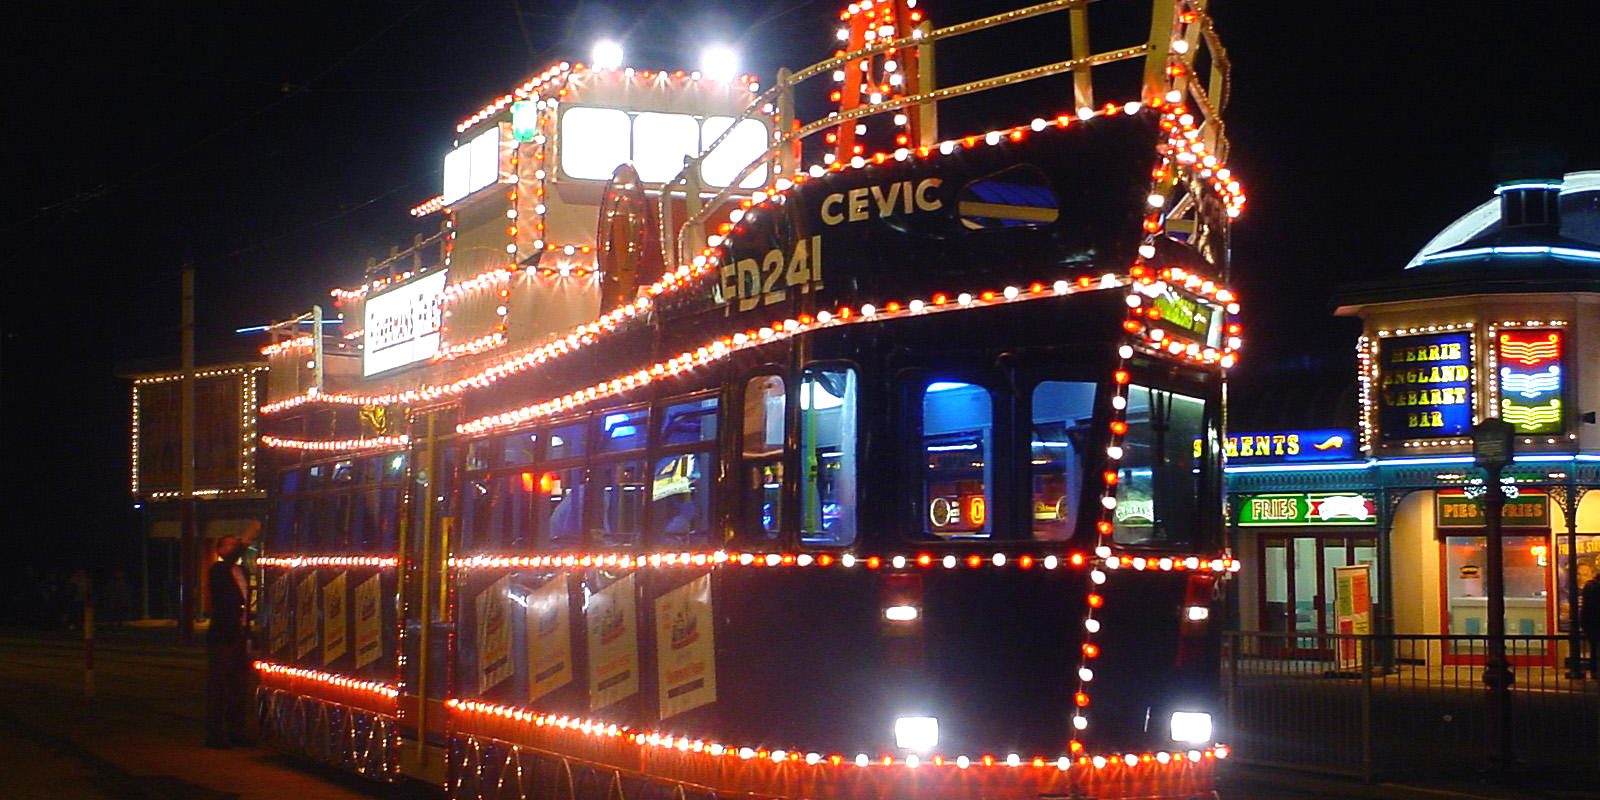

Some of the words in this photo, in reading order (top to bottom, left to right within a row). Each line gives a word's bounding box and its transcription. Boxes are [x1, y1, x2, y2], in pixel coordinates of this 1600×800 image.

[821, 178, 943, 226] CEVIC
[713, 235, 824, 318] FD241
[1408, 411, 1445, 428] BAR
[1251, 498, 1298, 521] FRIES
[1443, 503, 1478, 518] PIES
